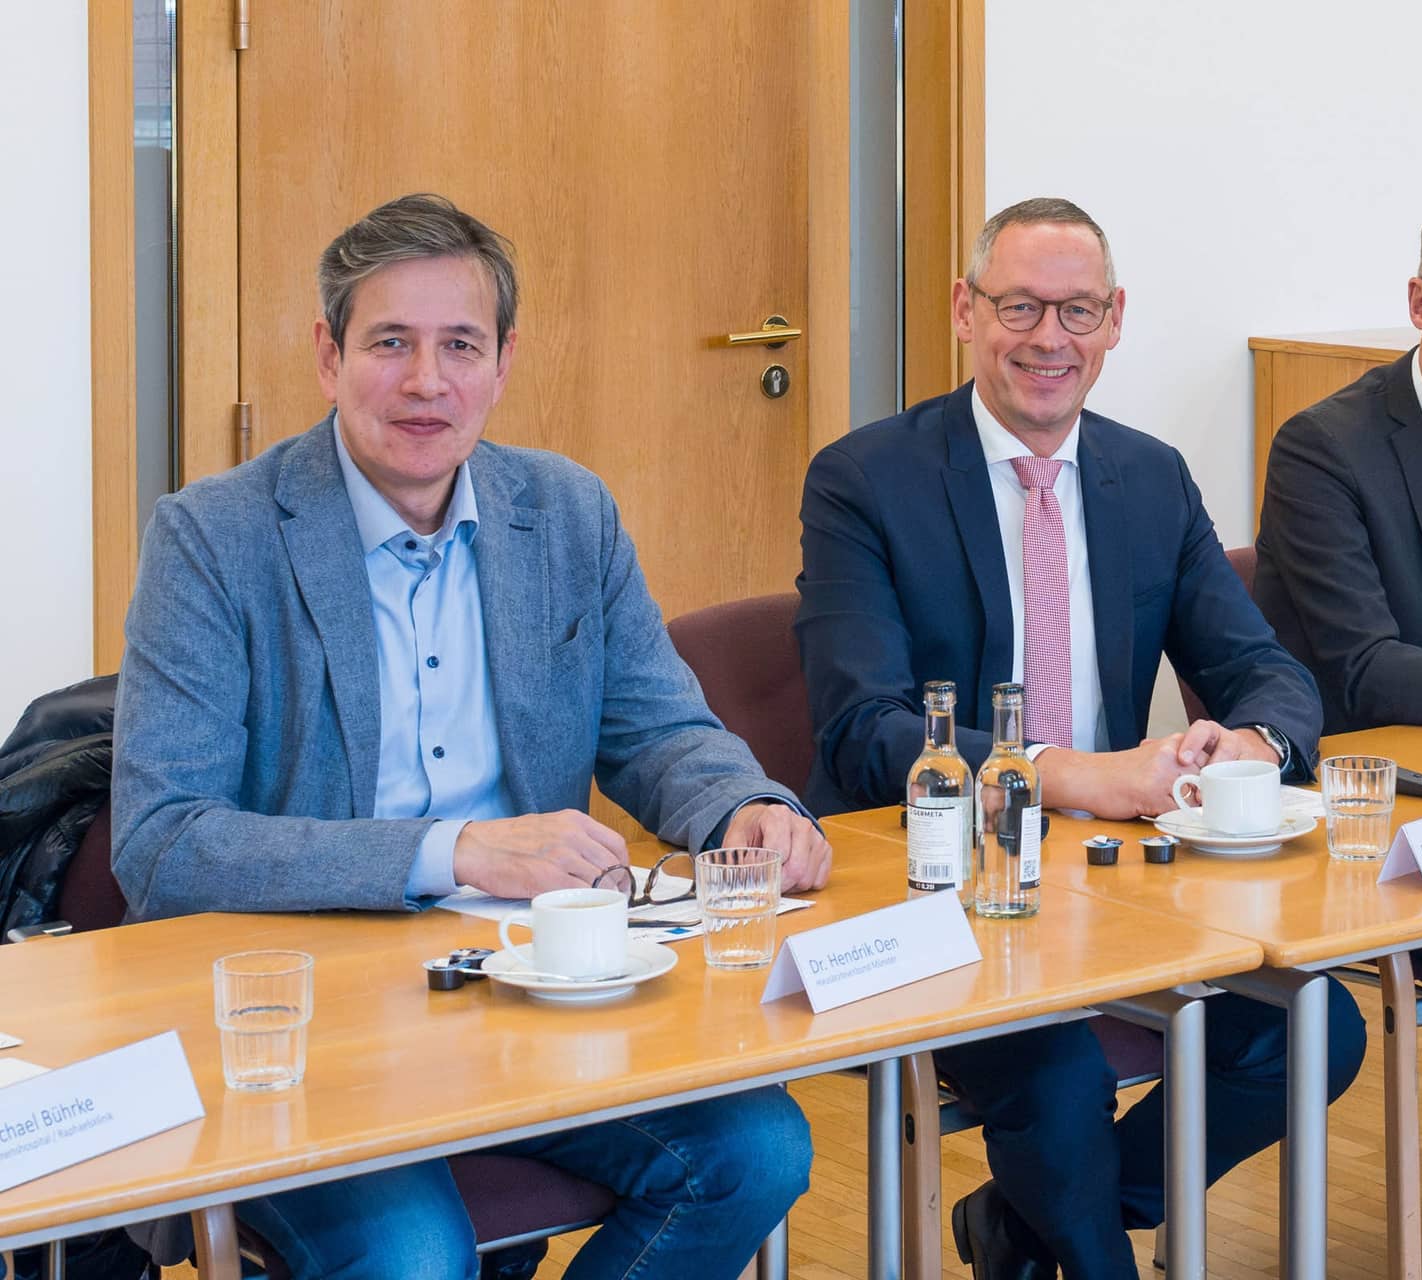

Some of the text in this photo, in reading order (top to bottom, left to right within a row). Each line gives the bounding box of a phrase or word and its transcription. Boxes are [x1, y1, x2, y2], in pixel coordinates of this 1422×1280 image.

[809, 937, 899, 974] Dr. Hendrik Oen
[40, 1096, 95, 1127] Bührke
